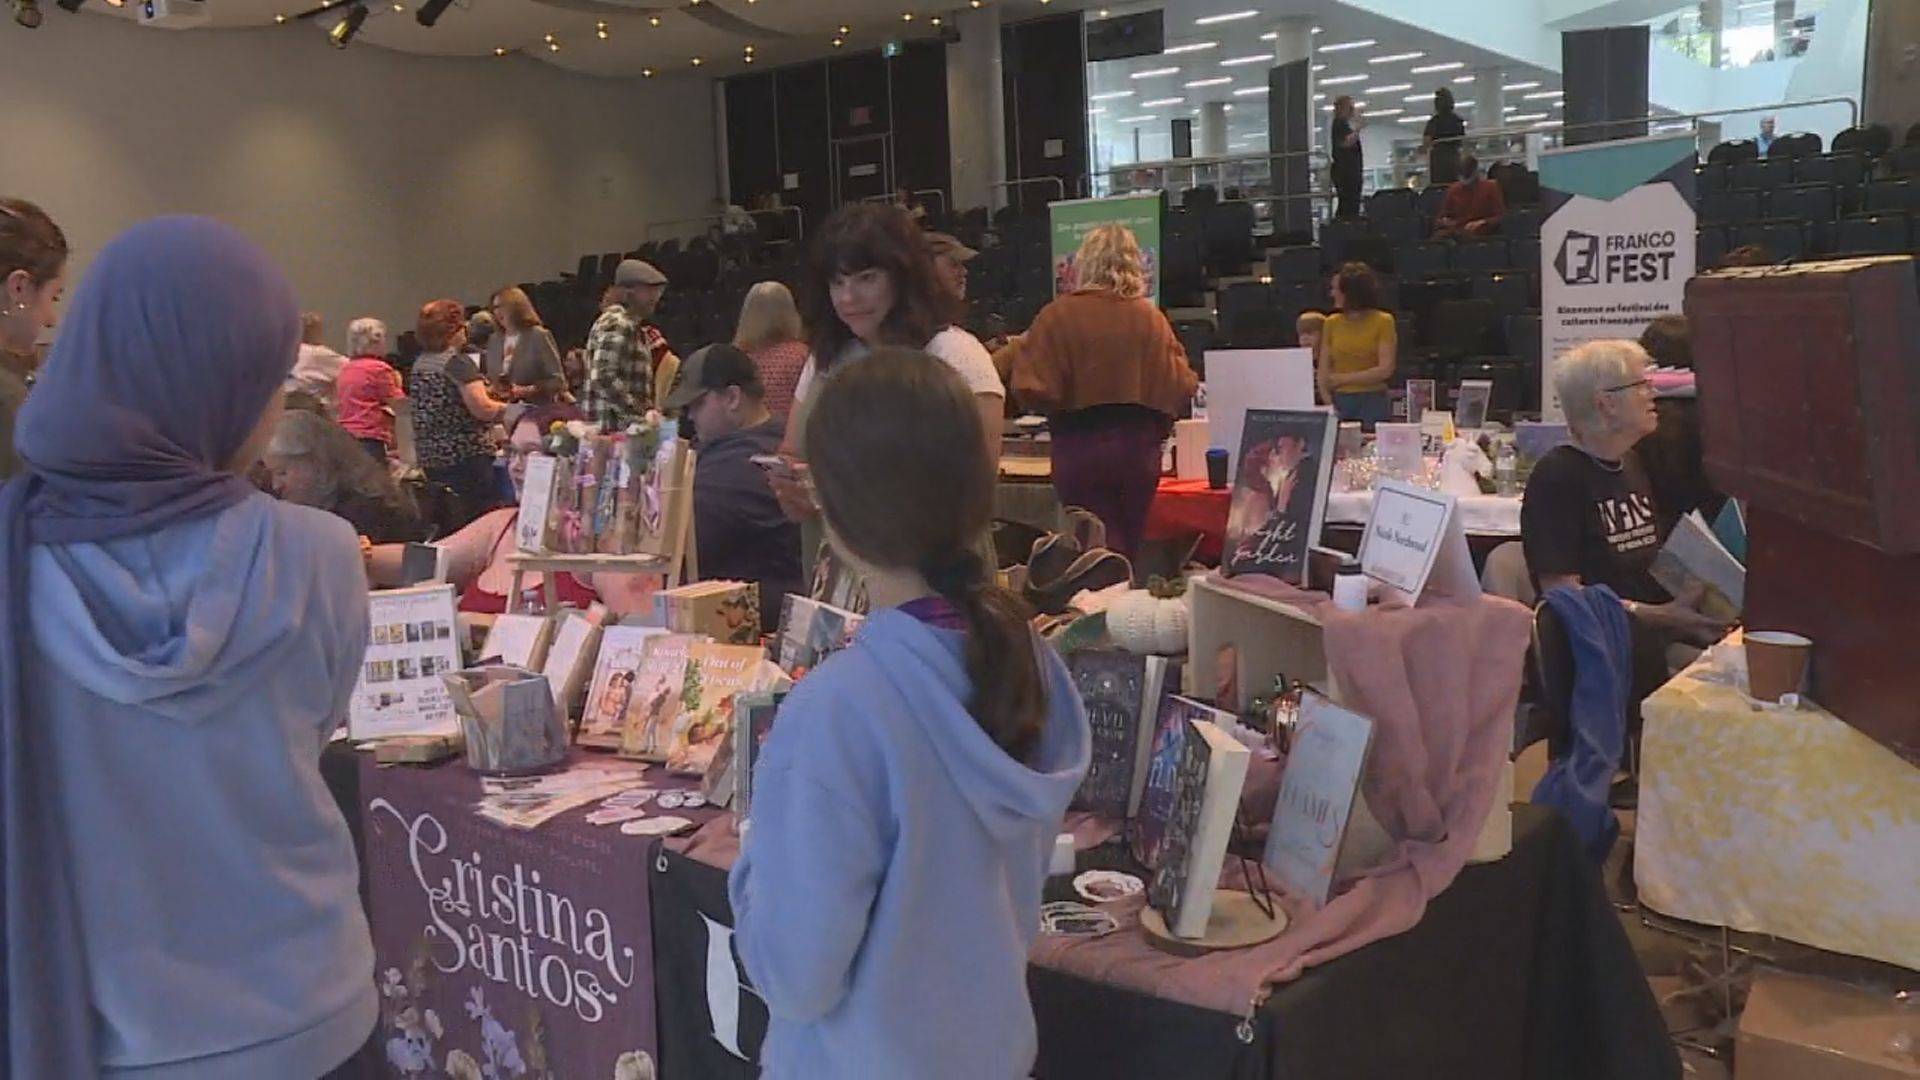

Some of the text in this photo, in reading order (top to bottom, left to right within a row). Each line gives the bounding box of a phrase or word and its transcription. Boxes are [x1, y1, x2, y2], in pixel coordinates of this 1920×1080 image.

[1606, 231, 1676, 251] FRANCO
[1606, 251, 1676, 283] FEST
[1617, 303, 1652, 313] festival
[1561, 317, 1598, 326] cultures
[369, 796, 634, 989] Cristina
[423, 890, 618, 1023] Santos
